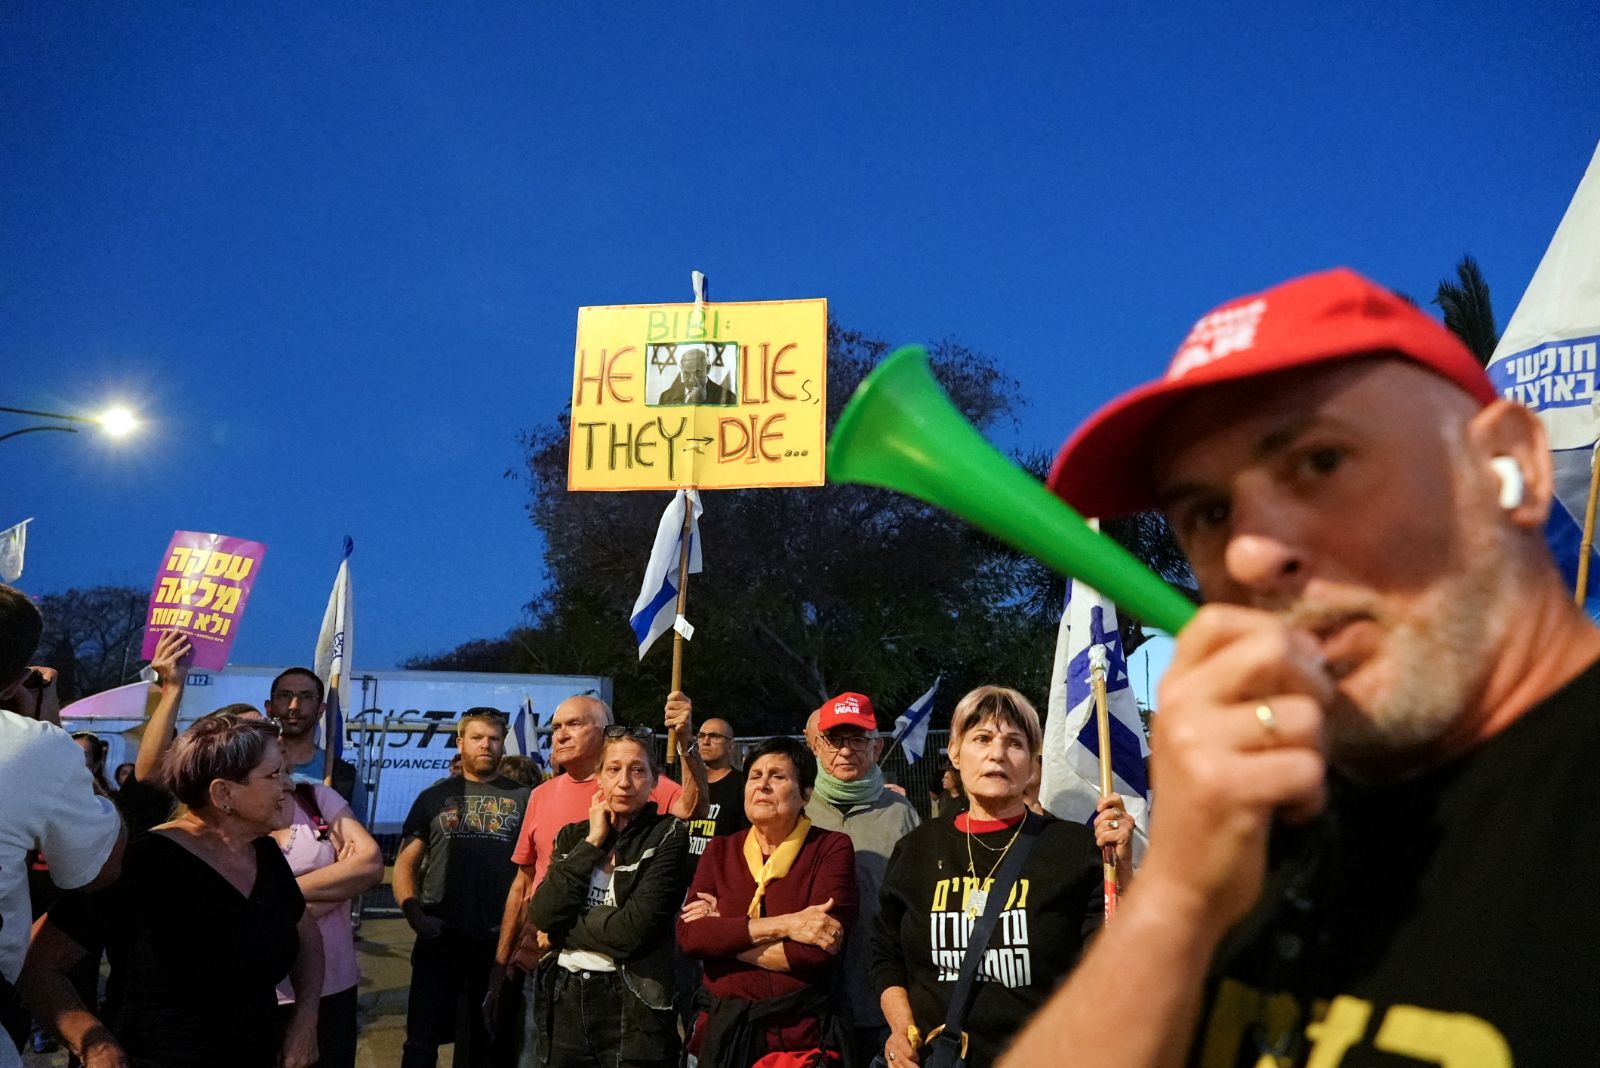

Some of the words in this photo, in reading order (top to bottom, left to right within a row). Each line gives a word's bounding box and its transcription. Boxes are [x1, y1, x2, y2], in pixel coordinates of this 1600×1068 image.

[647, 309, 731, 341] BIBI:
[575, 346, 637, 406] HE
[1505, 342, 1596, 384] חופשי
[578, 416, 687, 481] THEY
[718, 413, 809, 464] DIE...
[166, 547, 254, 581] עסקה
[155, 577, 242, 614] מלאה
[150, 608, 194, 628] פחות
[193, 612, 232, 636] ולא
[834, 705, 860, 714] WAR
[370, 759, 453, 769] ADVANCED
[999, 909, 1029, 945] עד
